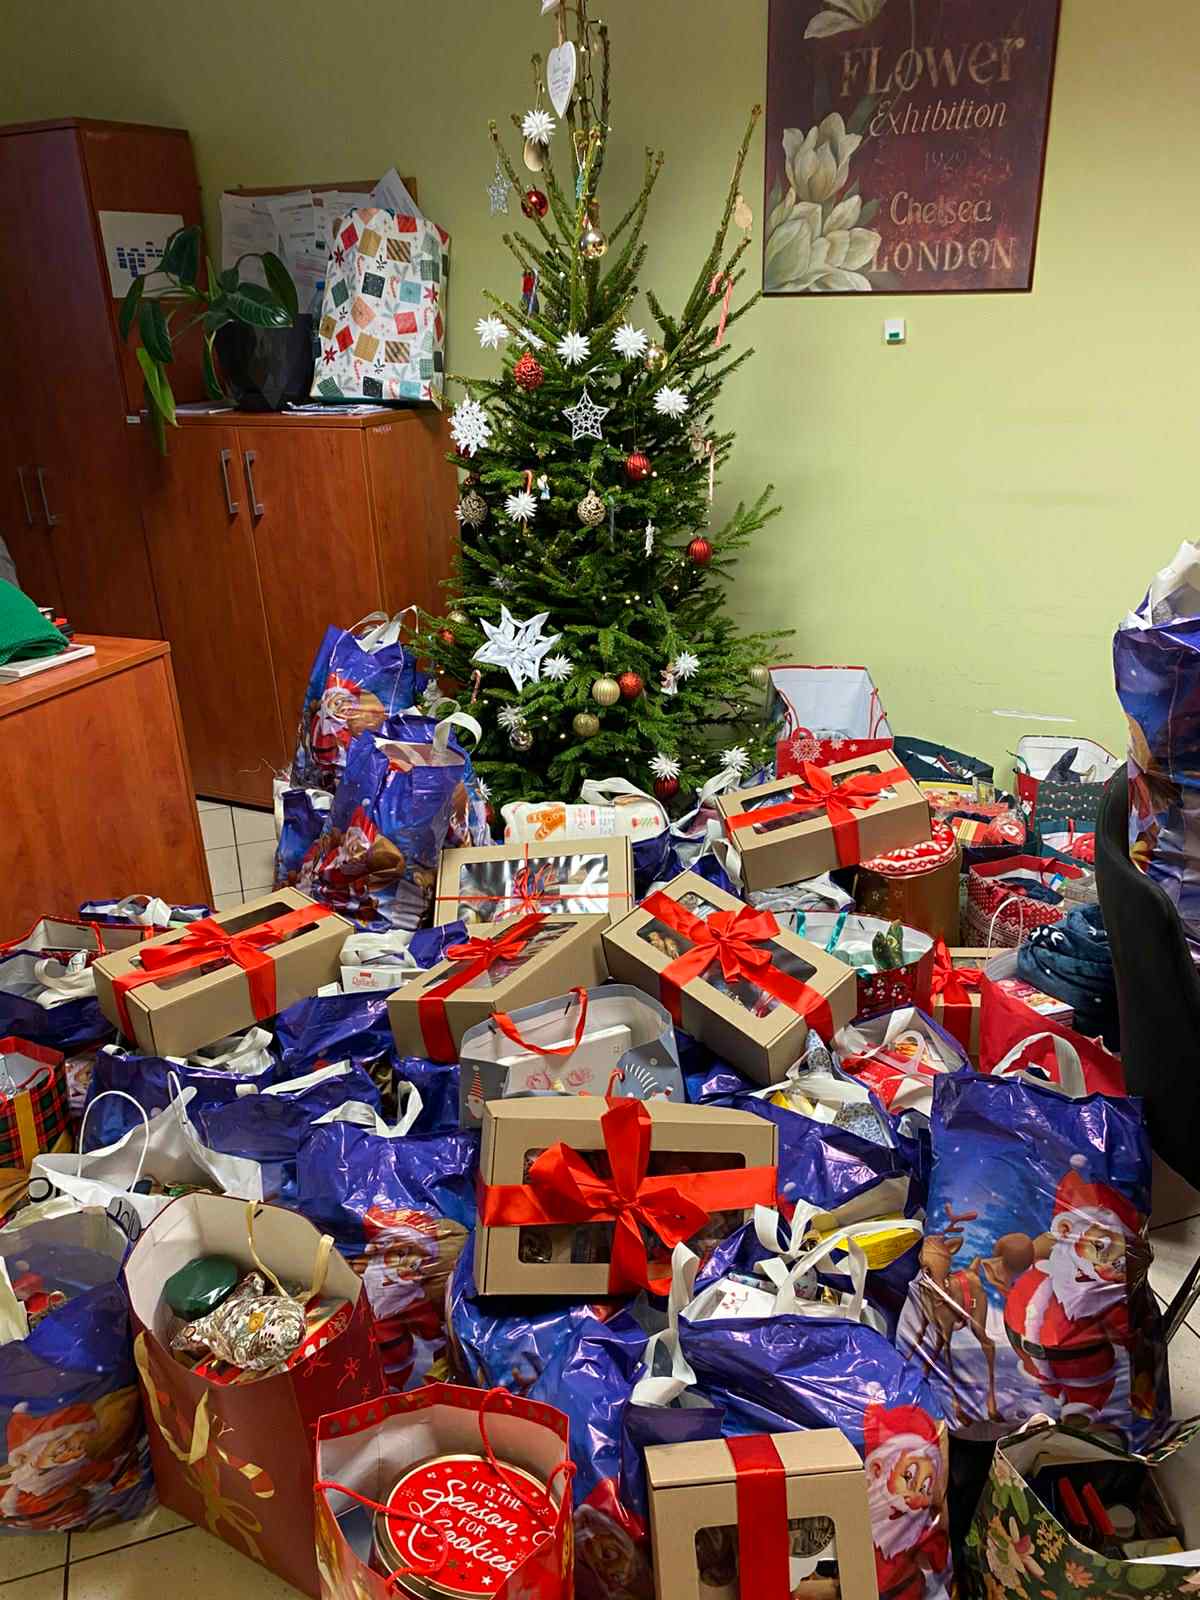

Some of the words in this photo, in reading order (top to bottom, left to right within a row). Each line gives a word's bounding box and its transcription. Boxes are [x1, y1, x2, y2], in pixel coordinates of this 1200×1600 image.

[870, 99, 1007, 137] Exhibition
[889, 191, 993, 225] Chelsea
[868, 237, 1017, 273] LONDON
[414, 1479, 518, 1535] Season
[471, 1480, 496, 1498] IT'S
[498, 1491, 523, 1511] THE
[457, 1516, 487, 1538] FOR
[414, 1518, 518, 1576] Cookies
